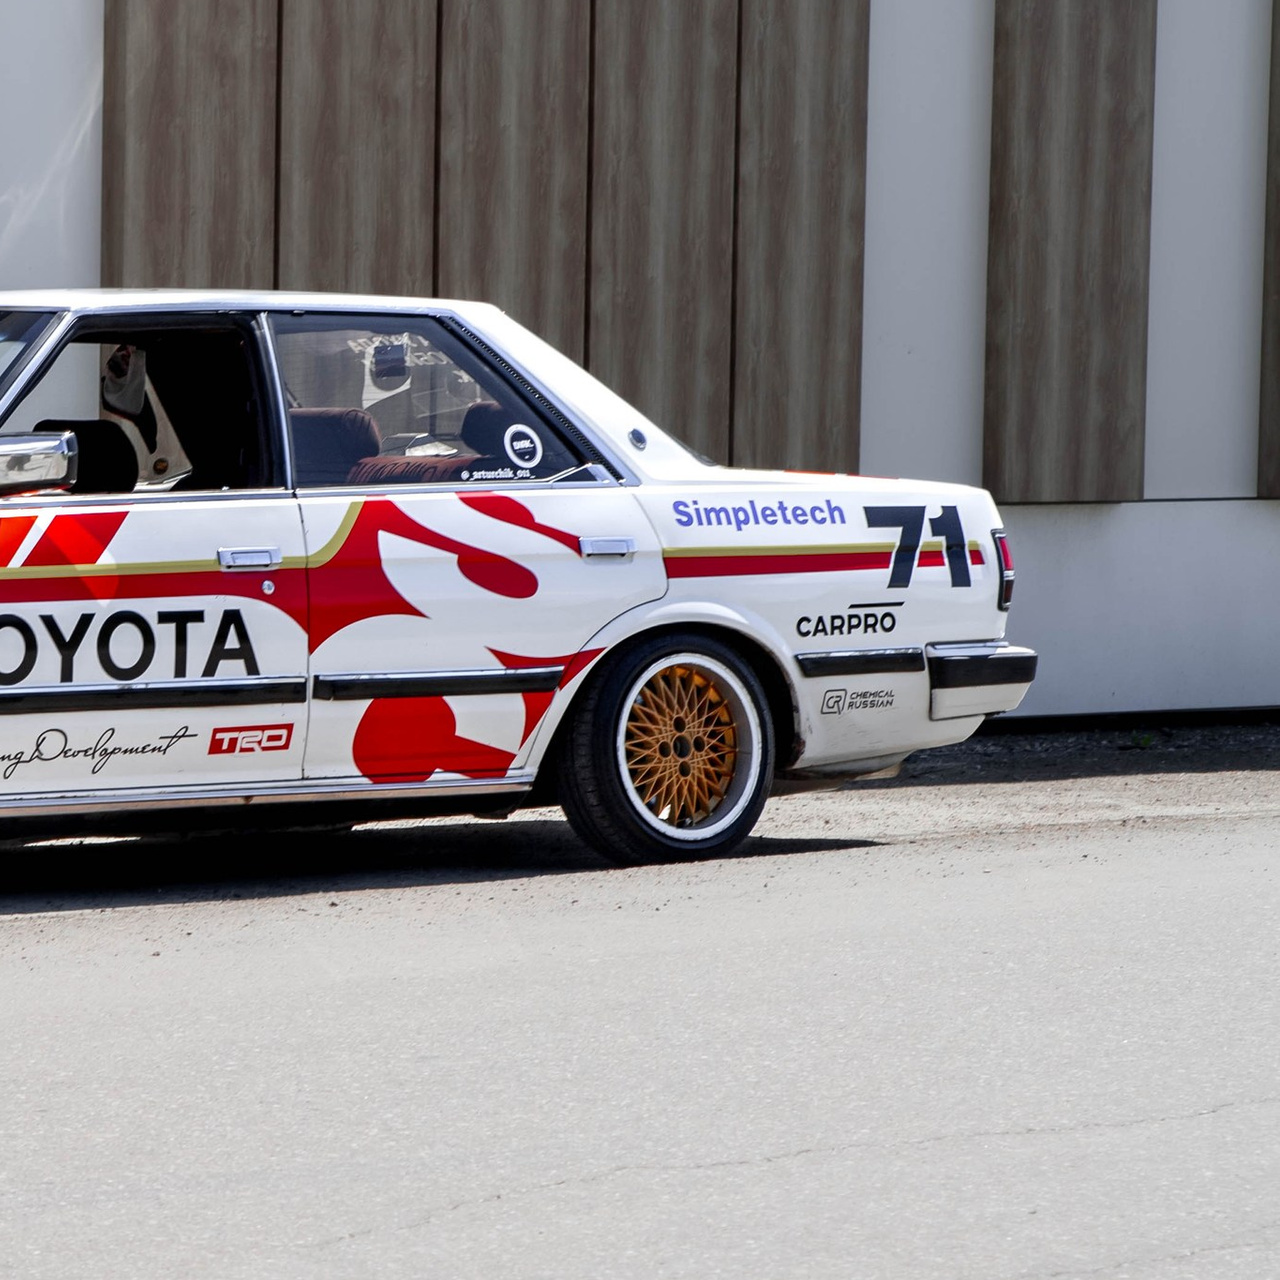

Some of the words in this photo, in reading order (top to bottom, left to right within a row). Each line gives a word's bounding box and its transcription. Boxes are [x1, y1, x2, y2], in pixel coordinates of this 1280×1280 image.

[672, 499, 847, 531] Simpletech
[863, 505, 972, 589] 71
[796, 611, 896, 637] CARPRO
[847, 699, 894, 710] RUSSIAN
[849, 690, 895, 701] CHEMICAL
[26, 725, 198, 775] Development
[214, 728, 289, 754] TRD
